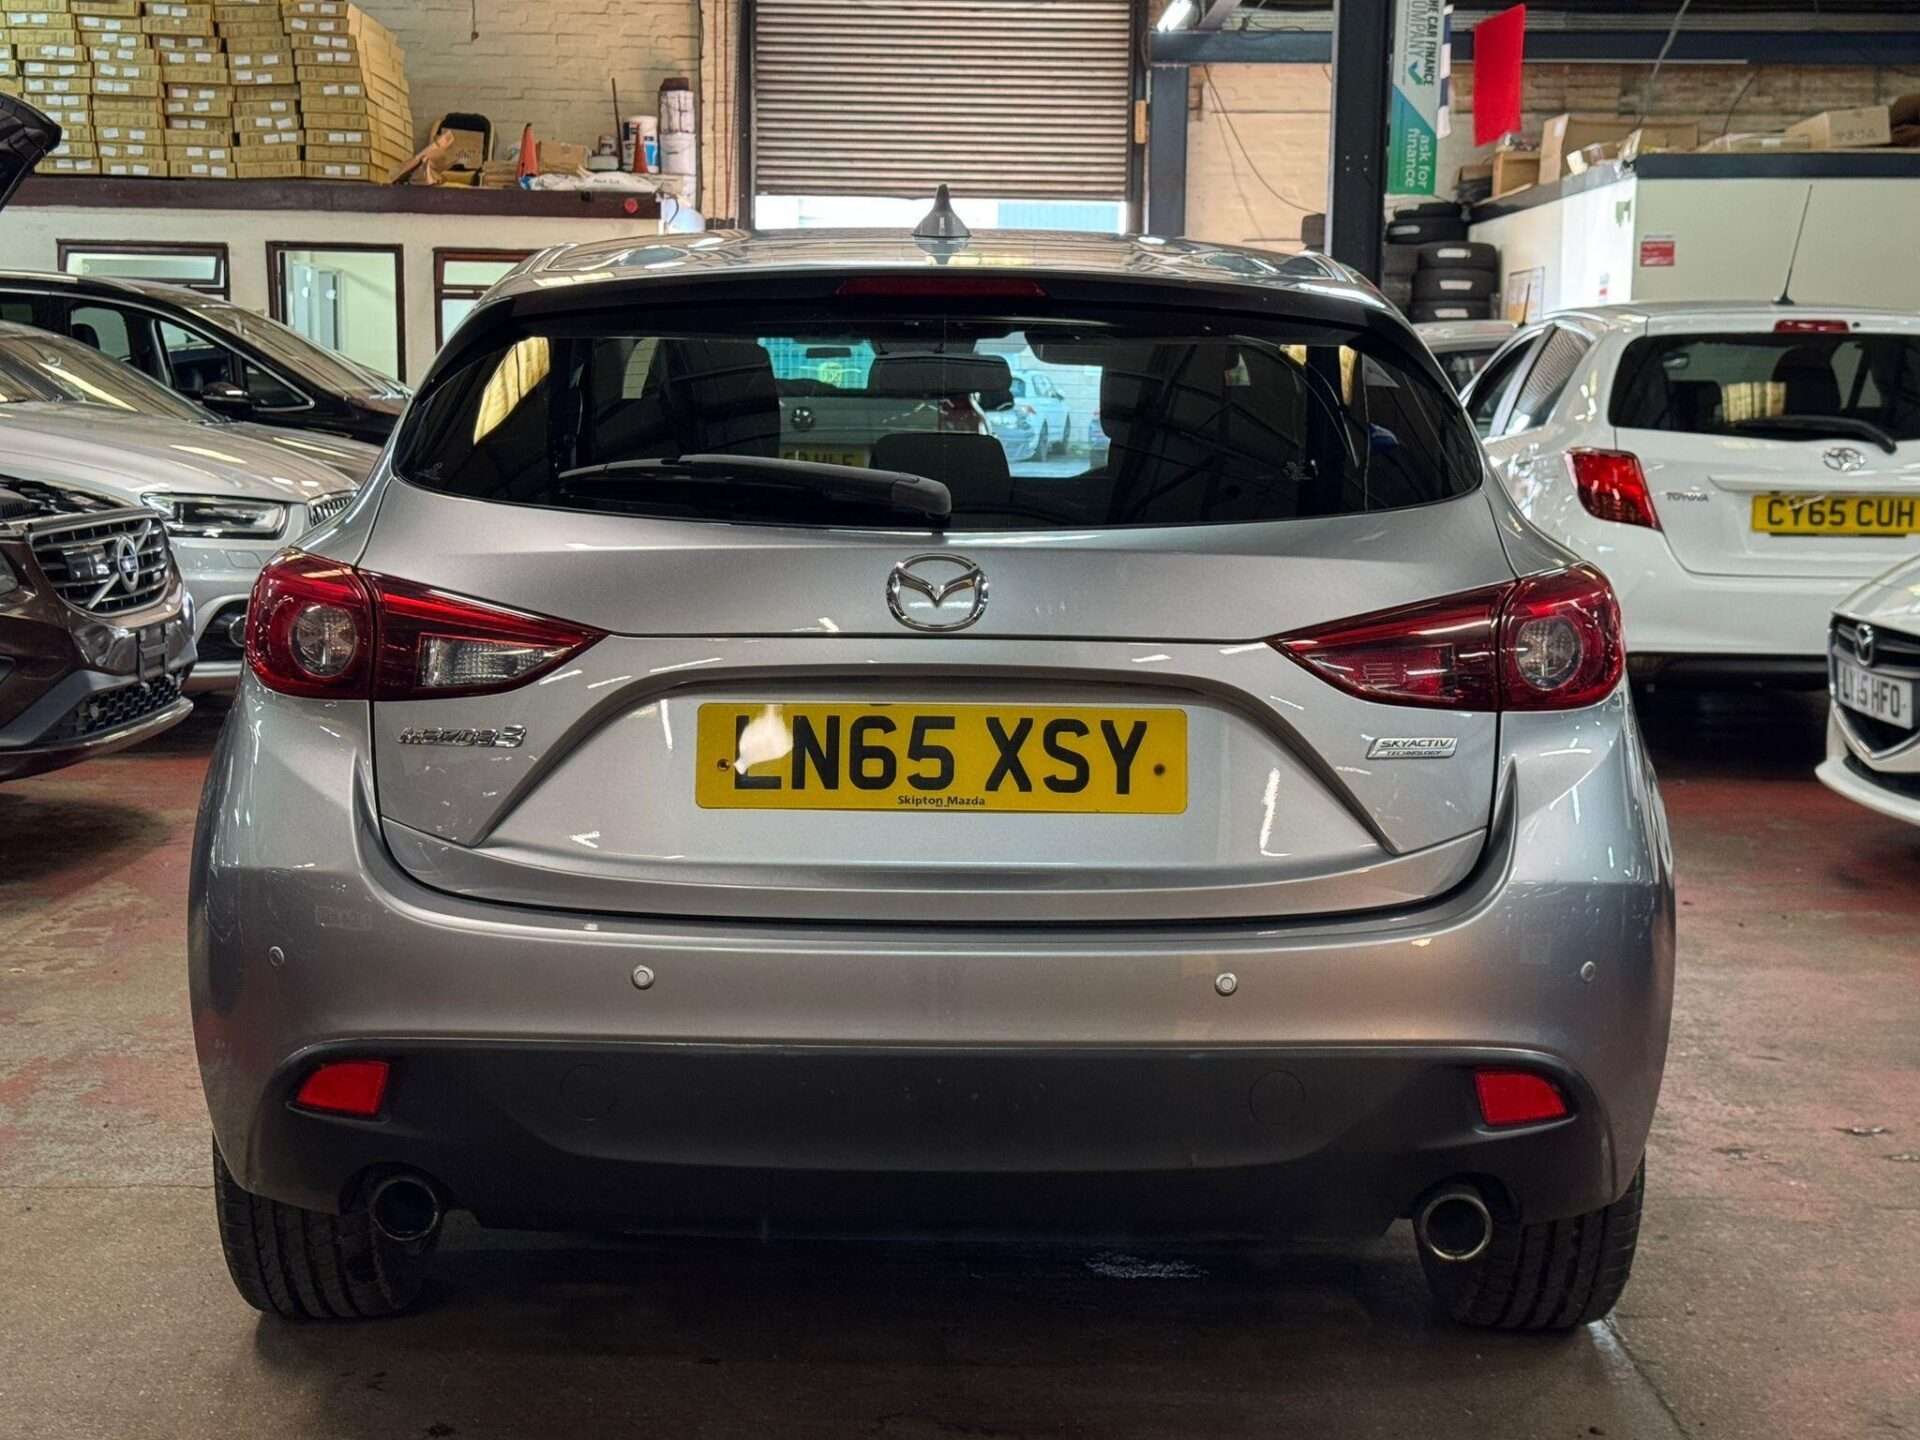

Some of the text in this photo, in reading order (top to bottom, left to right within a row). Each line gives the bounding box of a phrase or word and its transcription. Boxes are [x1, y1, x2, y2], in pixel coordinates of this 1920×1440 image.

[1409, 0, 1427, 58] OMPANY
[1424, 0, 1439, 87] HE CAR FINANCE
[1405, 127, 1421, 188] finance
[1417, 135, 1432, 189] ask for
[1768, 497, 1915, 528] CY65 CUH
[733, 714, 1148, 796] LN65 XSY
[1379, 739, 1450, 748] SKYACTIV
[897, 795, 985, 807] Skipton Mazda
